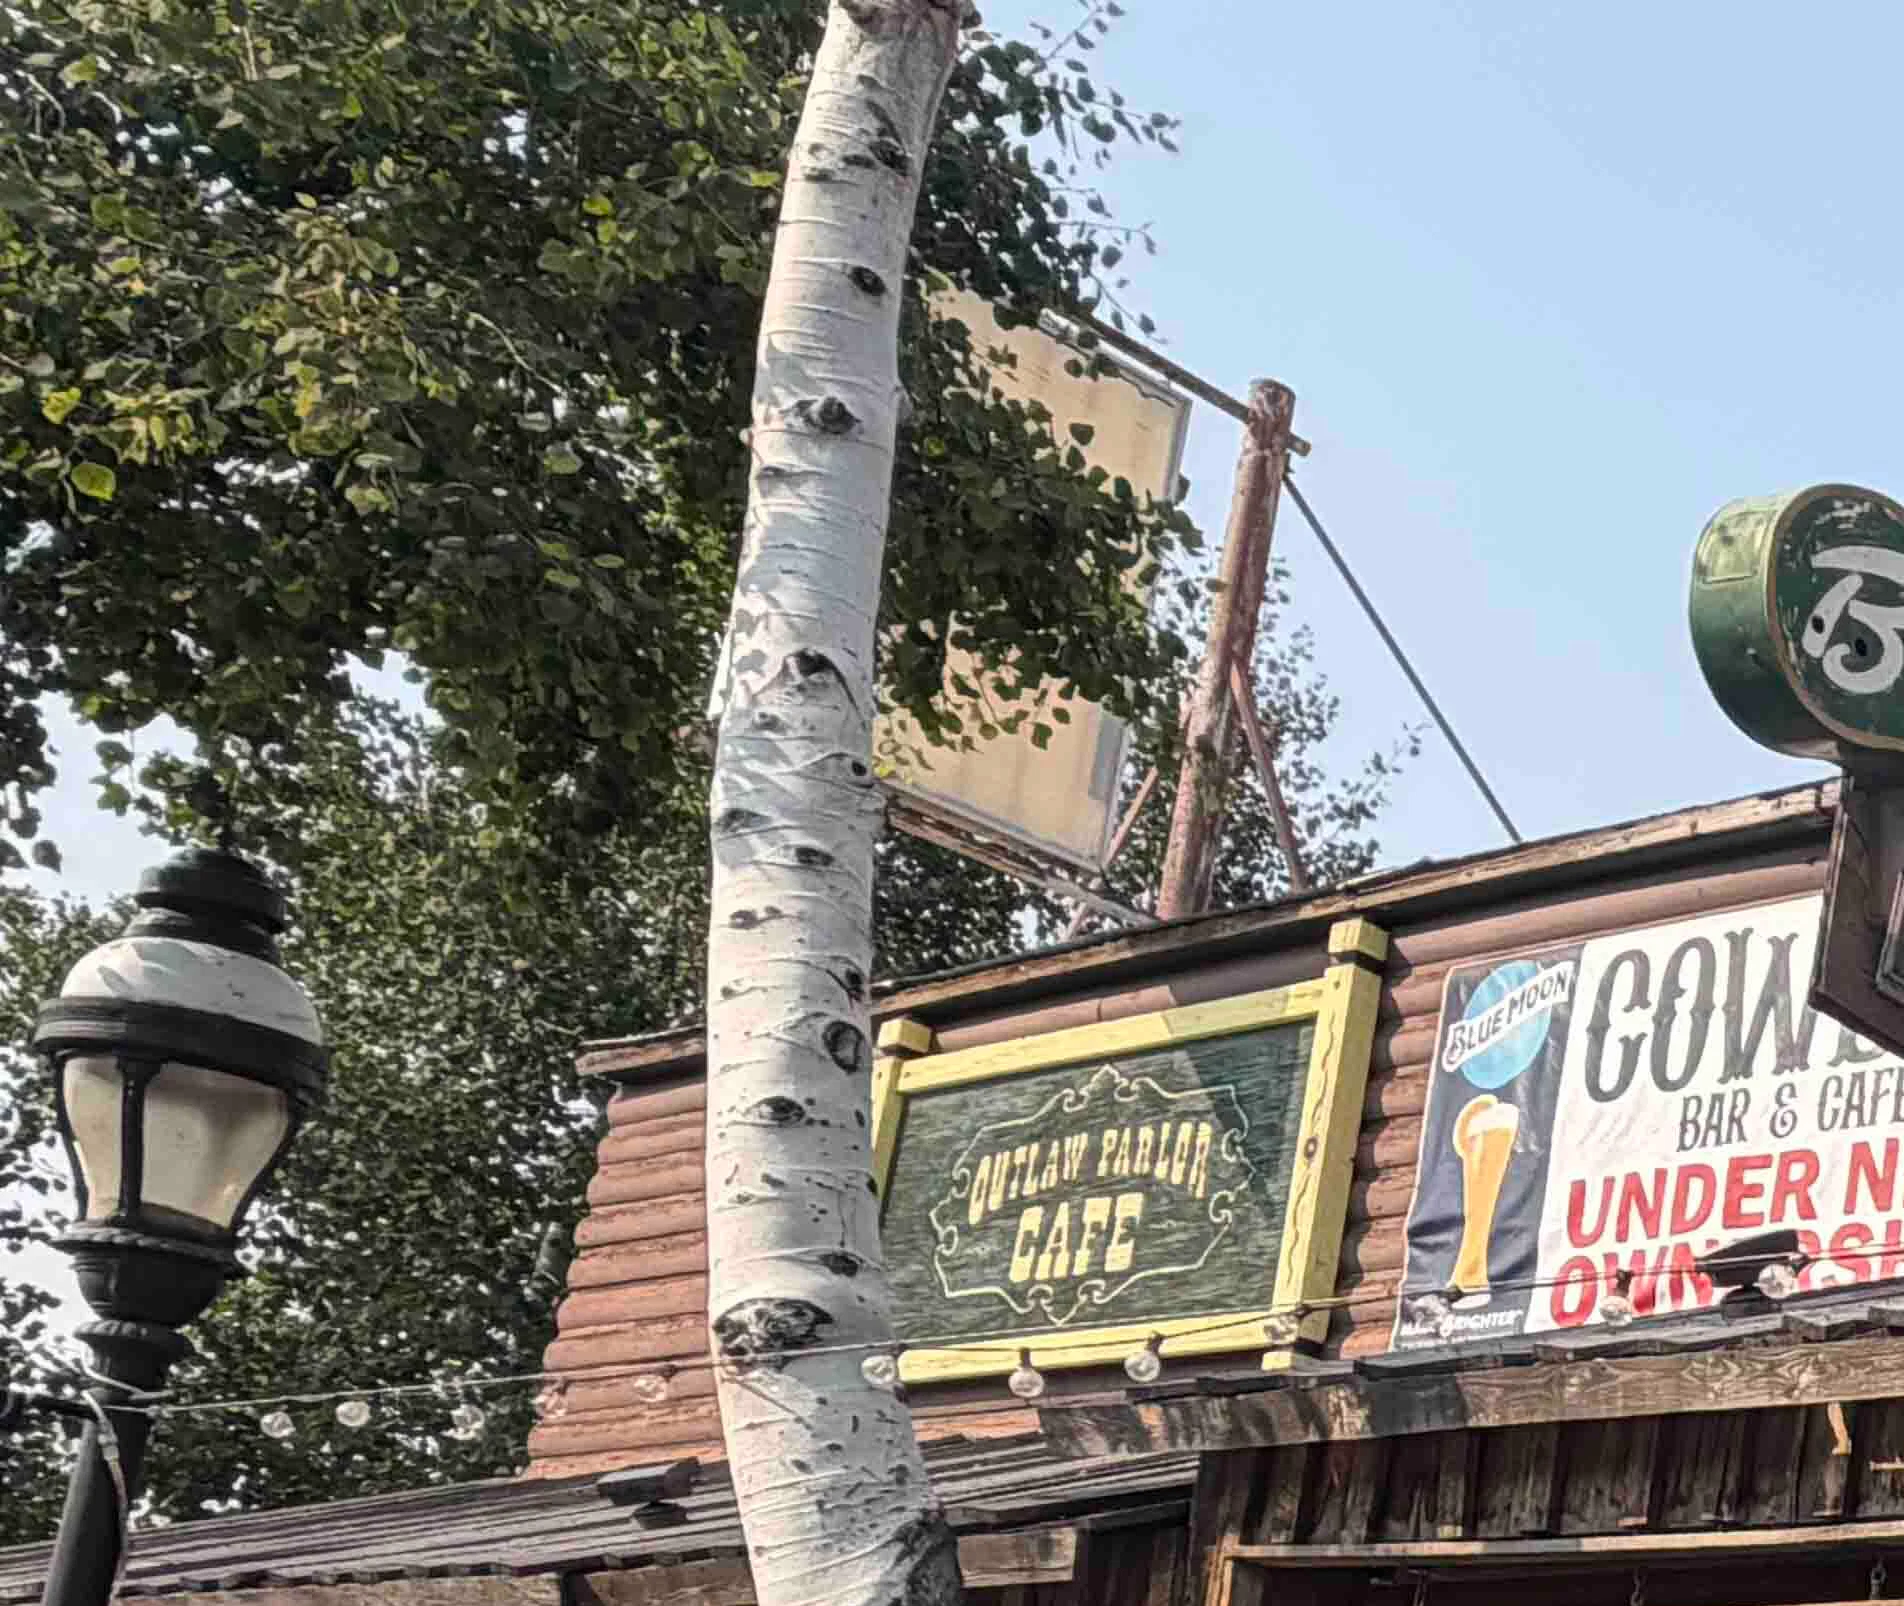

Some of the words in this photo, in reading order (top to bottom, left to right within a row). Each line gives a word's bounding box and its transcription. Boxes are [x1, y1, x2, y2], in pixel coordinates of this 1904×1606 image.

[1448, 1007, 1504, 1060] BLUE
[1507, 970, 1568, 1025] MOON
[1585, 927, 1885, 1103] COW
[1676, 1087, 1751, 1153] BAR
[1768, 1081, 1799, 1138] &
[968, 1131, 1089, 1225] OUTLAW
[1096, 1120, 1213, 1199] PARLOR
[1566, 1148, 1821, 1250] UNDER
[1009, 1191, 1145, 1284] CAFE
